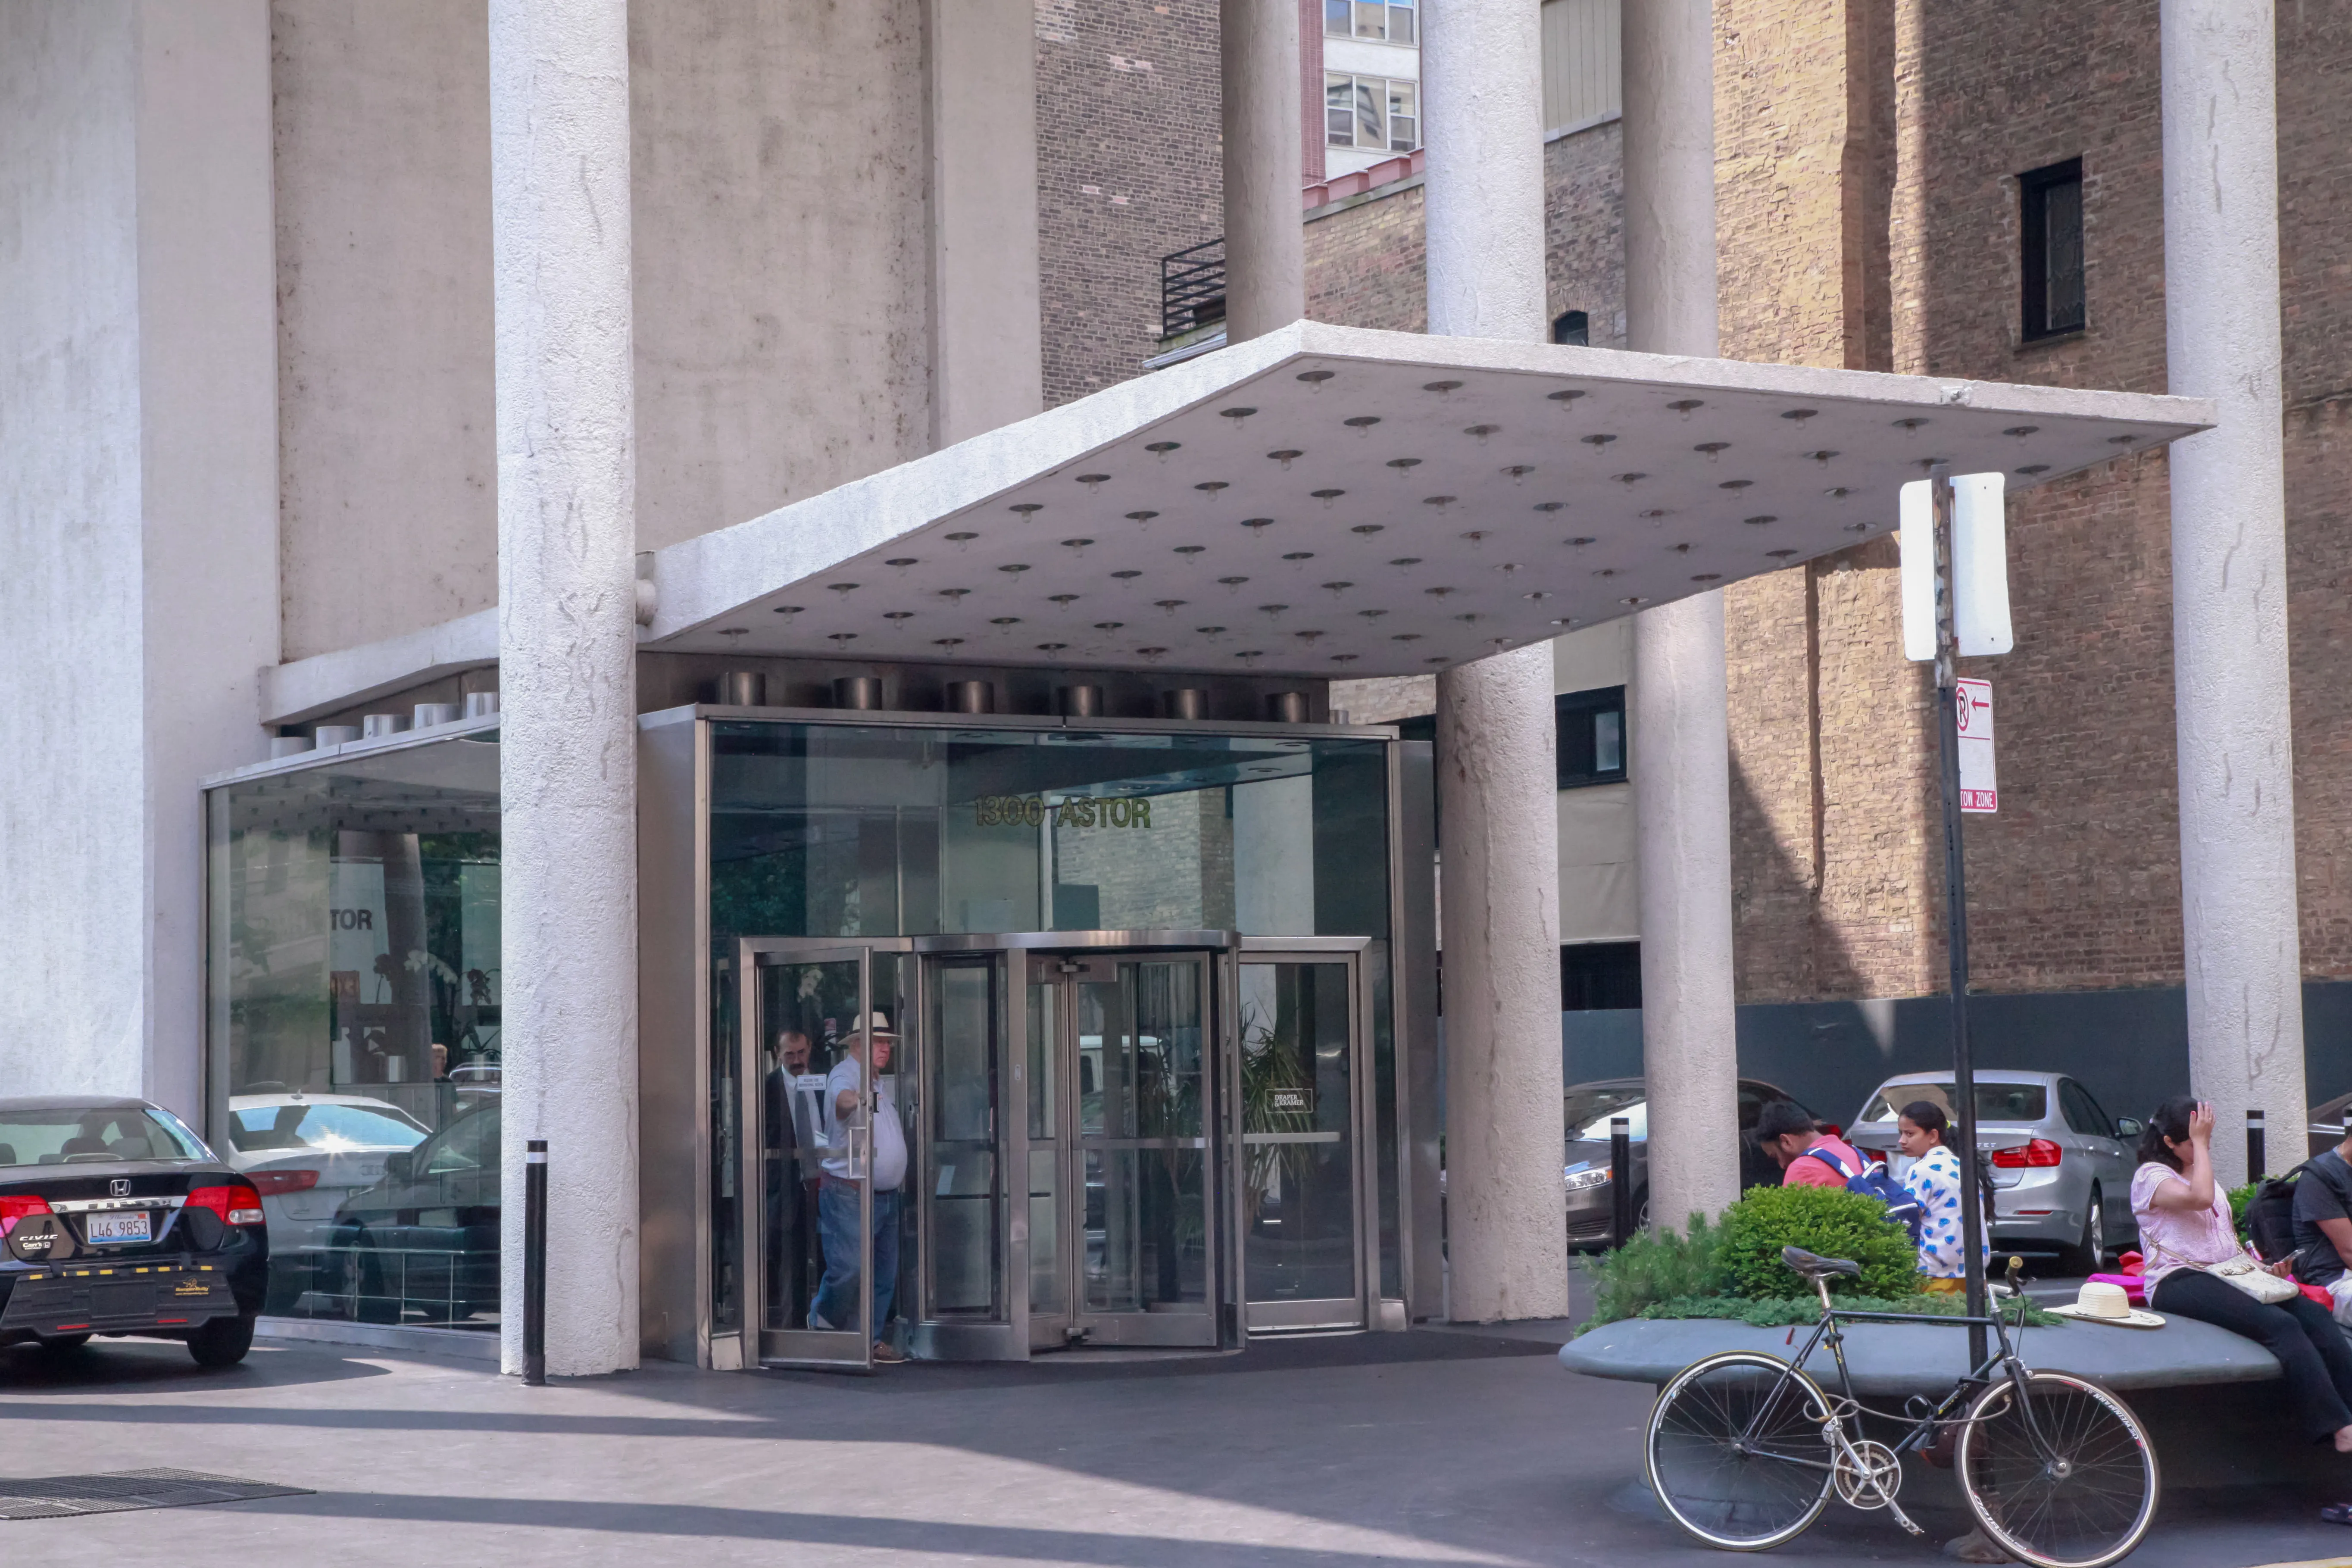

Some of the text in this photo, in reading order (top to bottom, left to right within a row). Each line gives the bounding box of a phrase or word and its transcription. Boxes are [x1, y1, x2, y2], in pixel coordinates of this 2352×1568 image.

[975, 795, 1151, 828] 1300 ASTOR
[1976, 791, 1994, 807] ZONE
[90, 1221, 147, 1238] L46 9853
[2093, 1393, 2132, 1427] WEINMANN
